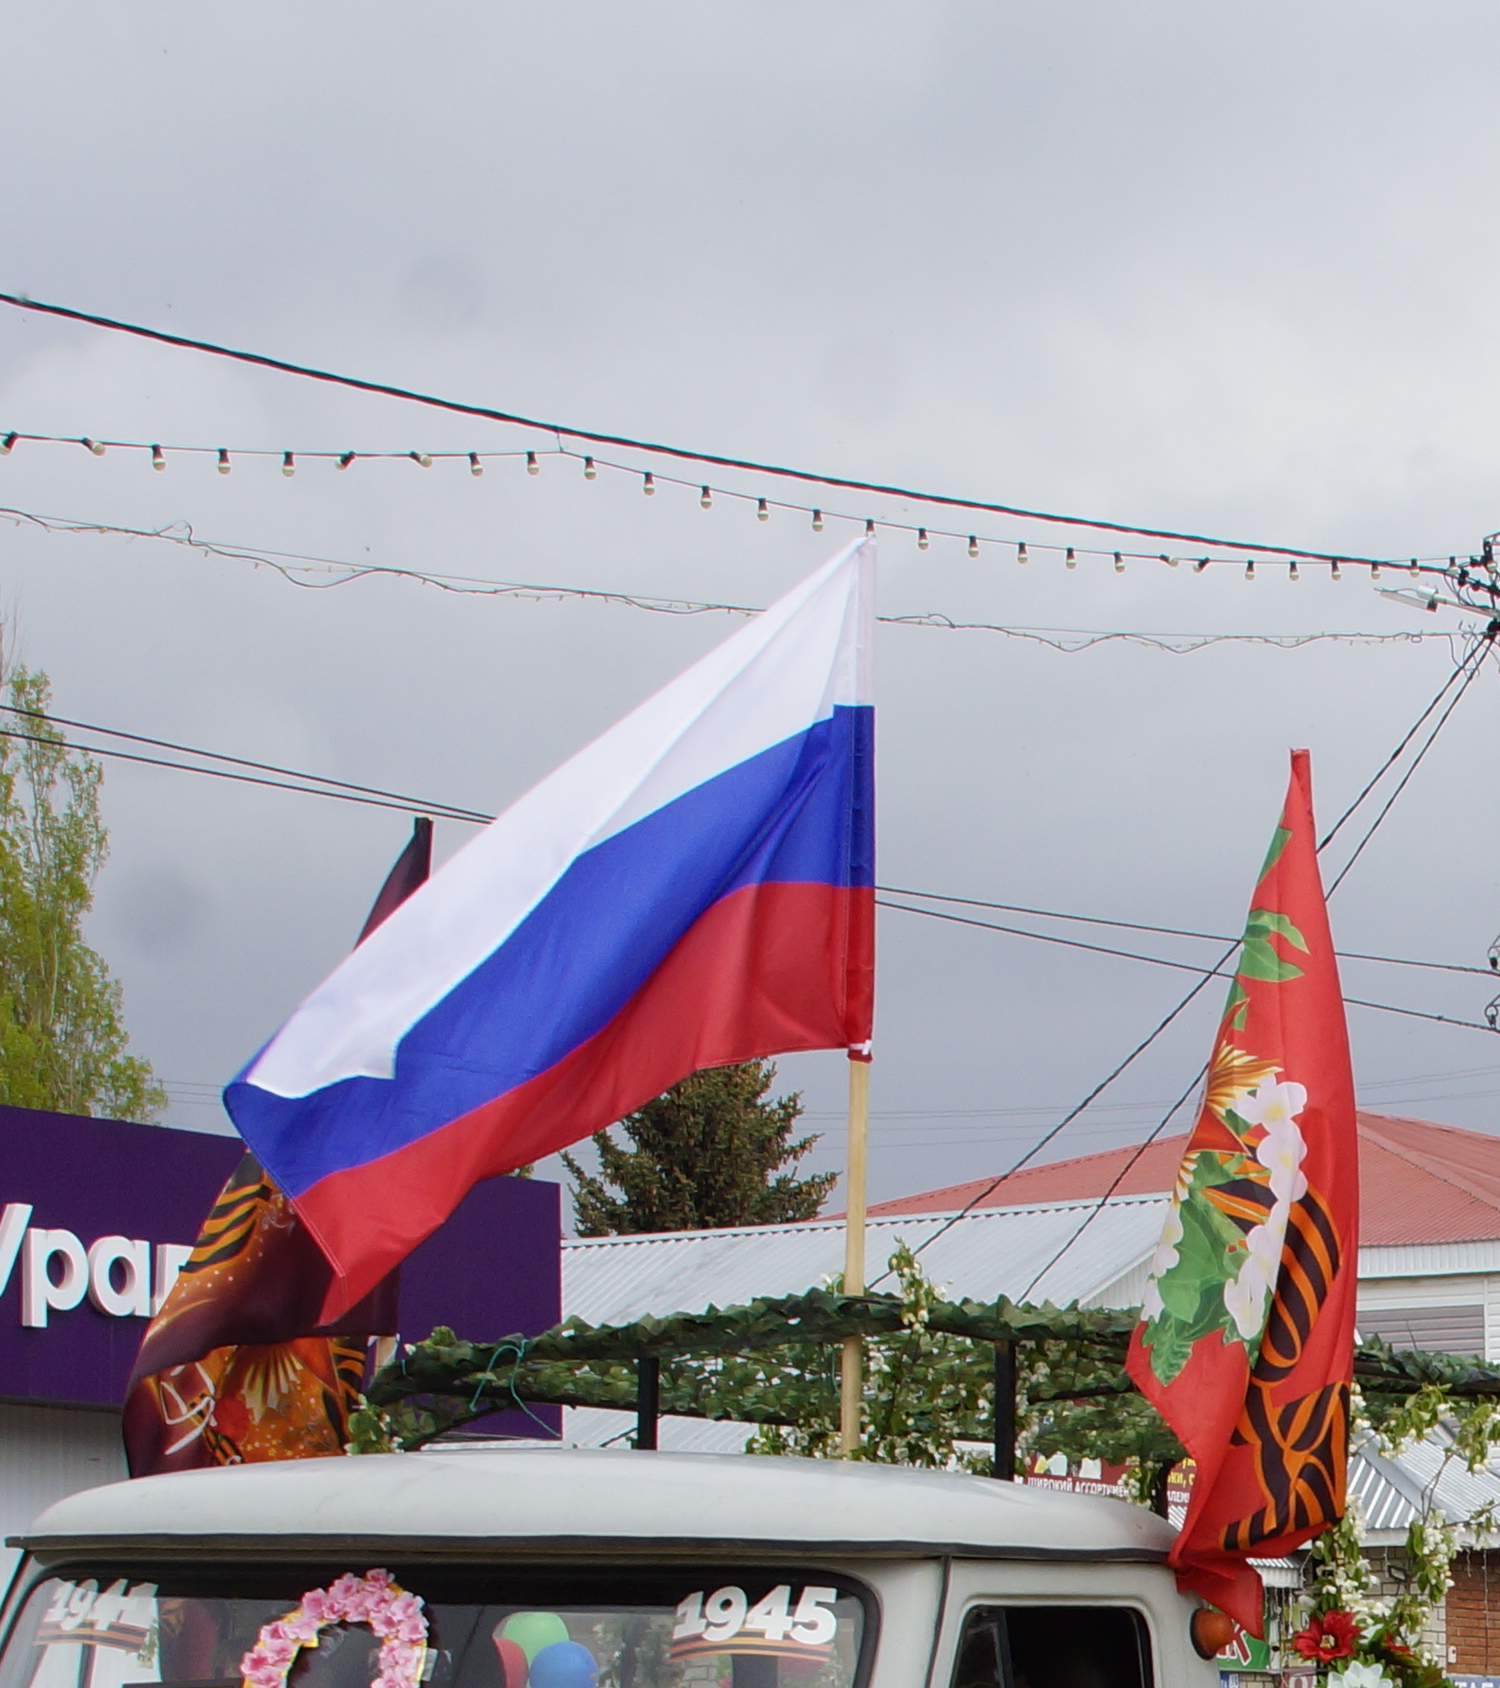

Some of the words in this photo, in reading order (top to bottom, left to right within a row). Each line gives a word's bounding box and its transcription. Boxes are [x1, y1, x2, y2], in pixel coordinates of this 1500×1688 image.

[1027, 1477, 1073, 1493] ШИРОКИЙ
[1075, 1481, 1130, 1498] АССОРТИМЕН
[673, 1585, 837, 1645] 1945
